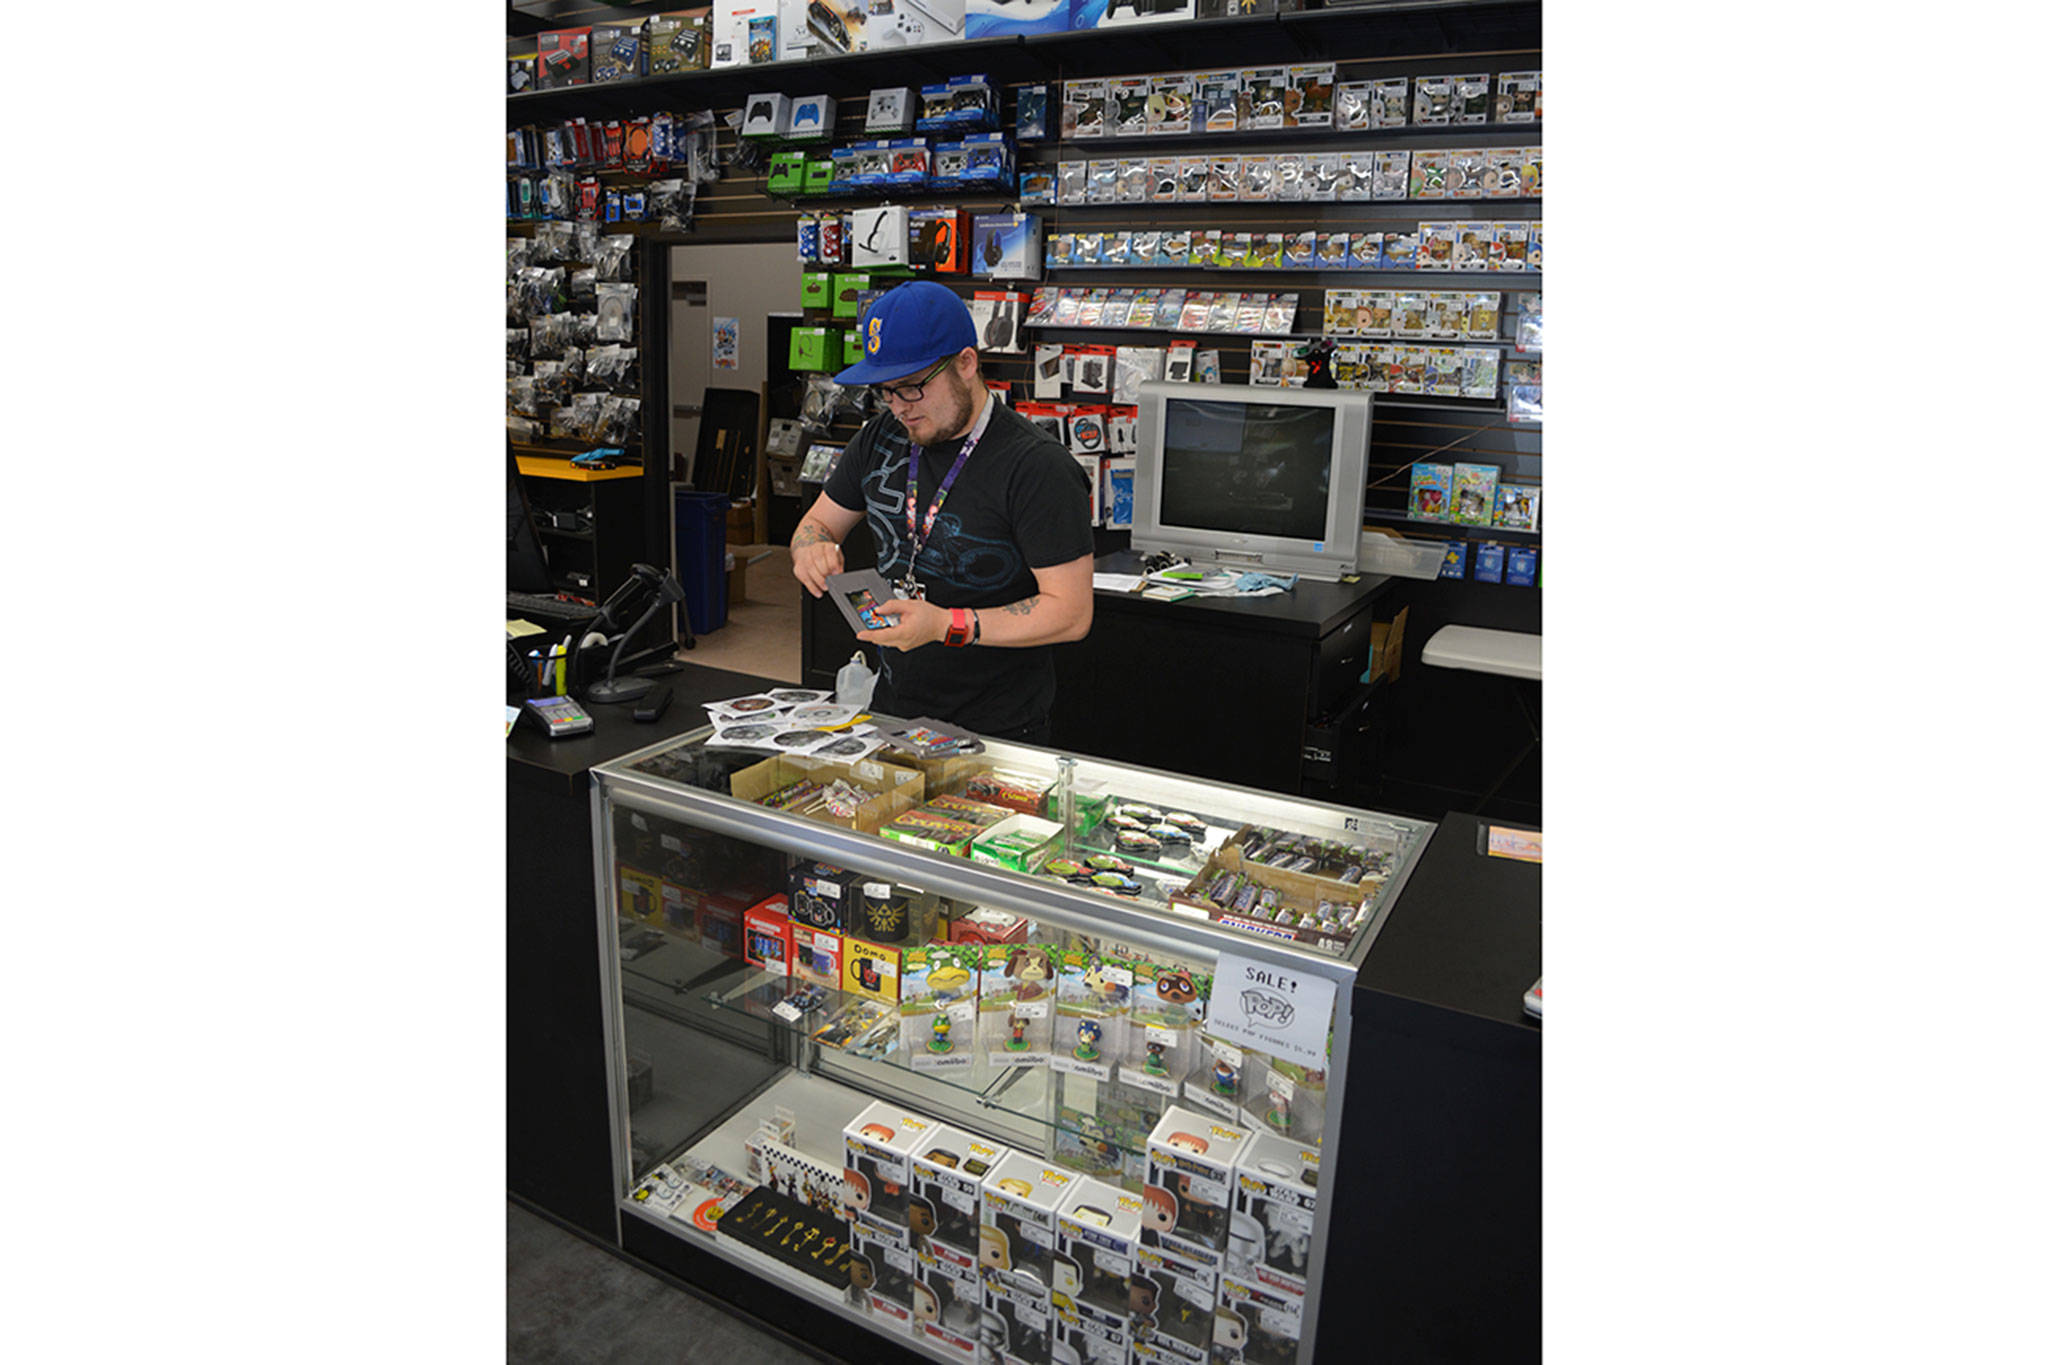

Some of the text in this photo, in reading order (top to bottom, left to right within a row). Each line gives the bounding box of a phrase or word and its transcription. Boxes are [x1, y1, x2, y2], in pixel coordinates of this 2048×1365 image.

[868, 317, 883, 354] S
[1245, 966, 1298, 993] SALE!
[1241, 990, 1294, 1024] POP!
